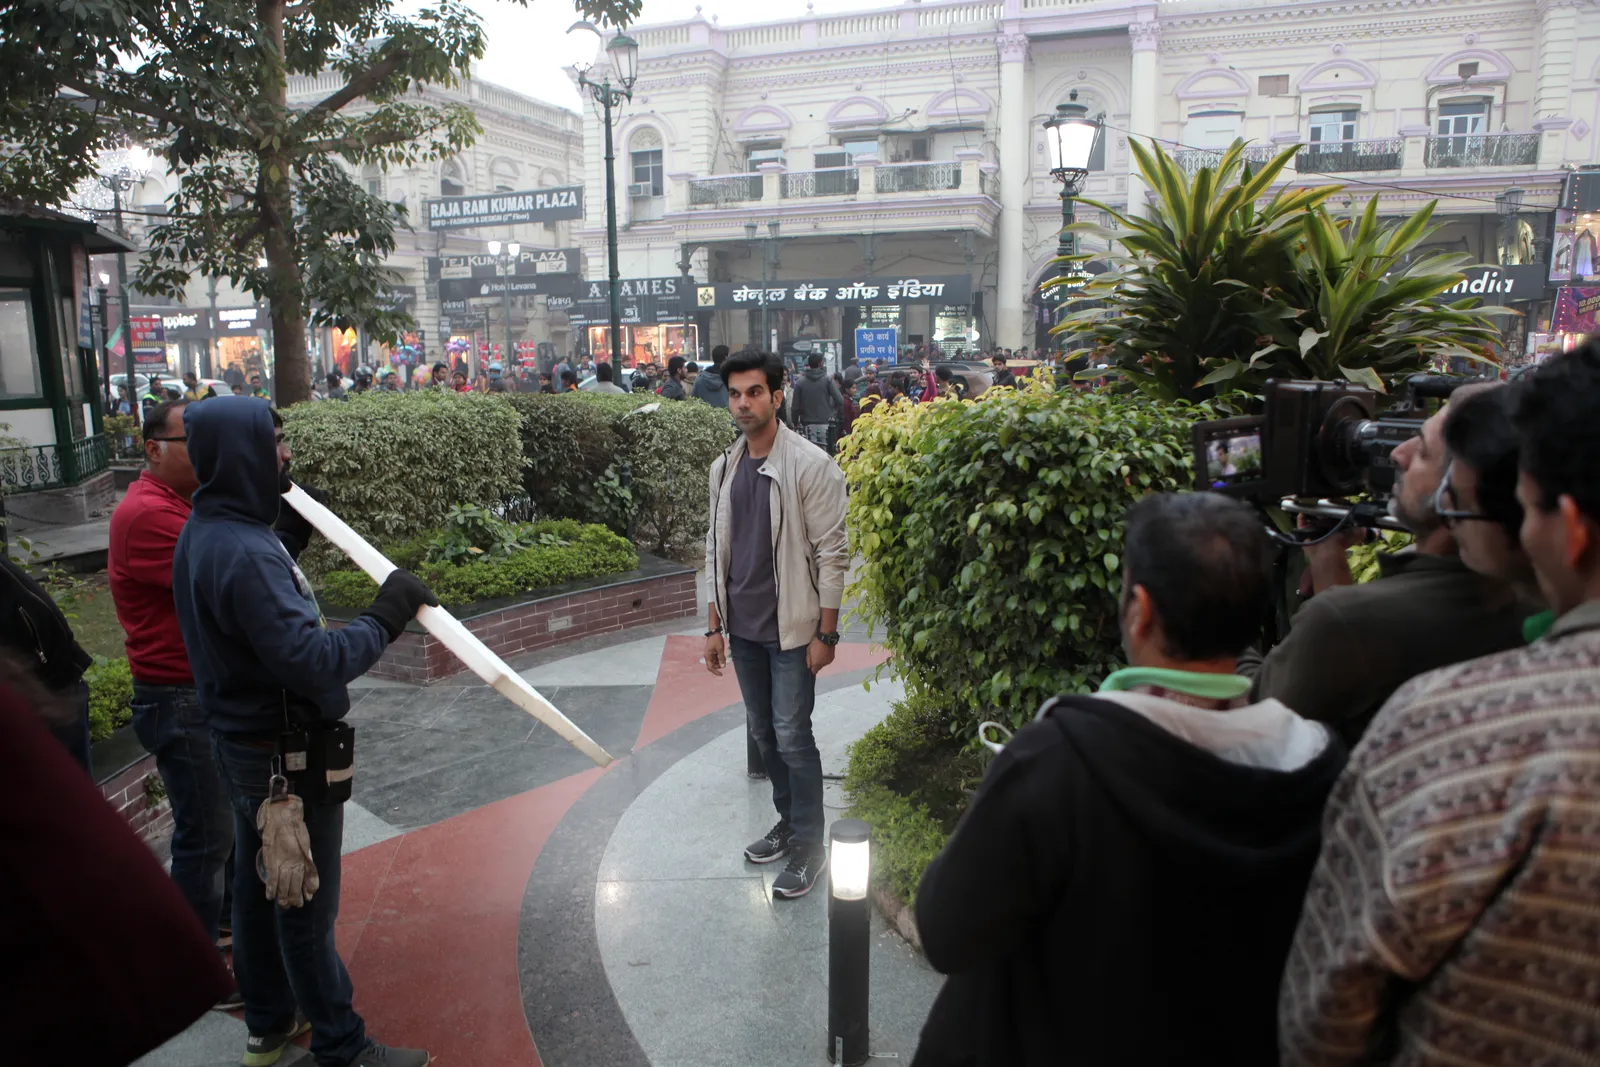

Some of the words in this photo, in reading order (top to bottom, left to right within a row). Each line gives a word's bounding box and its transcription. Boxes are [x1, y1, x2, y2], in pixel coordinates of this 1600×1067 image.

[430, 200, 460, 218] RAJA
[462, 198, 489, 216] RAM
[491, 195, 534, 213] KUMAR
[536, 191, 577, 209] PLAZA
[440, 257, 464, 267] TEJ
[468, 255, 515, 267] KUMR
[520, 251, 567, 263] PLAZA
[794, 283, 829, 301] बैंक
[887, 279, 945, 299] इंडिया
[862, 331, 874, 342] मेट्रो
[876, 331, 889, 341] कार्य
[860, 345, 875, 354] प्रगति
[877, 346, 885, 354] पर
